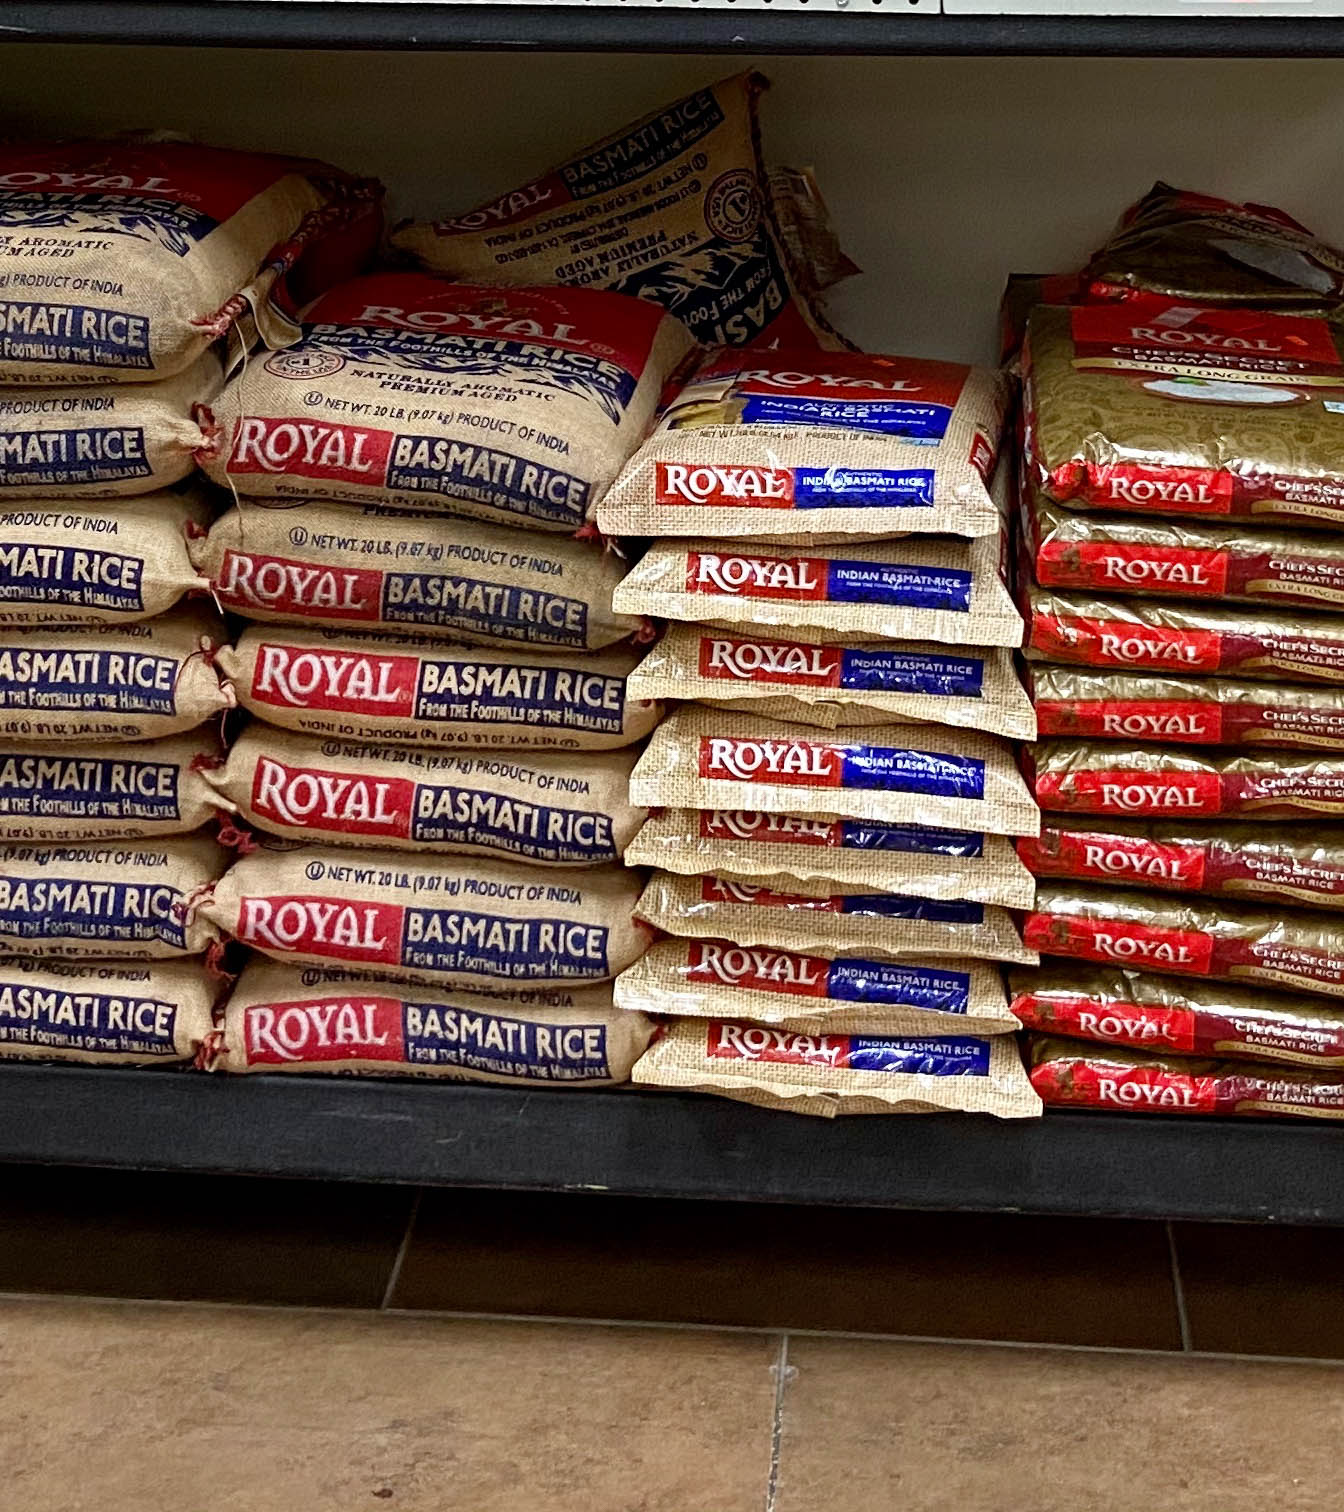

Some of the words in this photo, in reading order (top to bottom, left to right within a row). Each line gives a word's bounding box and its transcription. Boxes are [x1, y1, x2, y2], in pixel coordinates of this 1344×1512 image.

[83, 310, 147, 349] RICE
[1104, 556, 1209, 585] ROYAL
[261, 645, 401, 706] ROYAL
[710, 640, 838, 679] ROYAL
[850, 659, 891, 669] INDIAN
[895, 660, 943, 672] BASMATI
[946, 664, 973, 675] RICE
[422, 663, 544, 698] BASMATI
[555, 671, 623, 711] RICE
